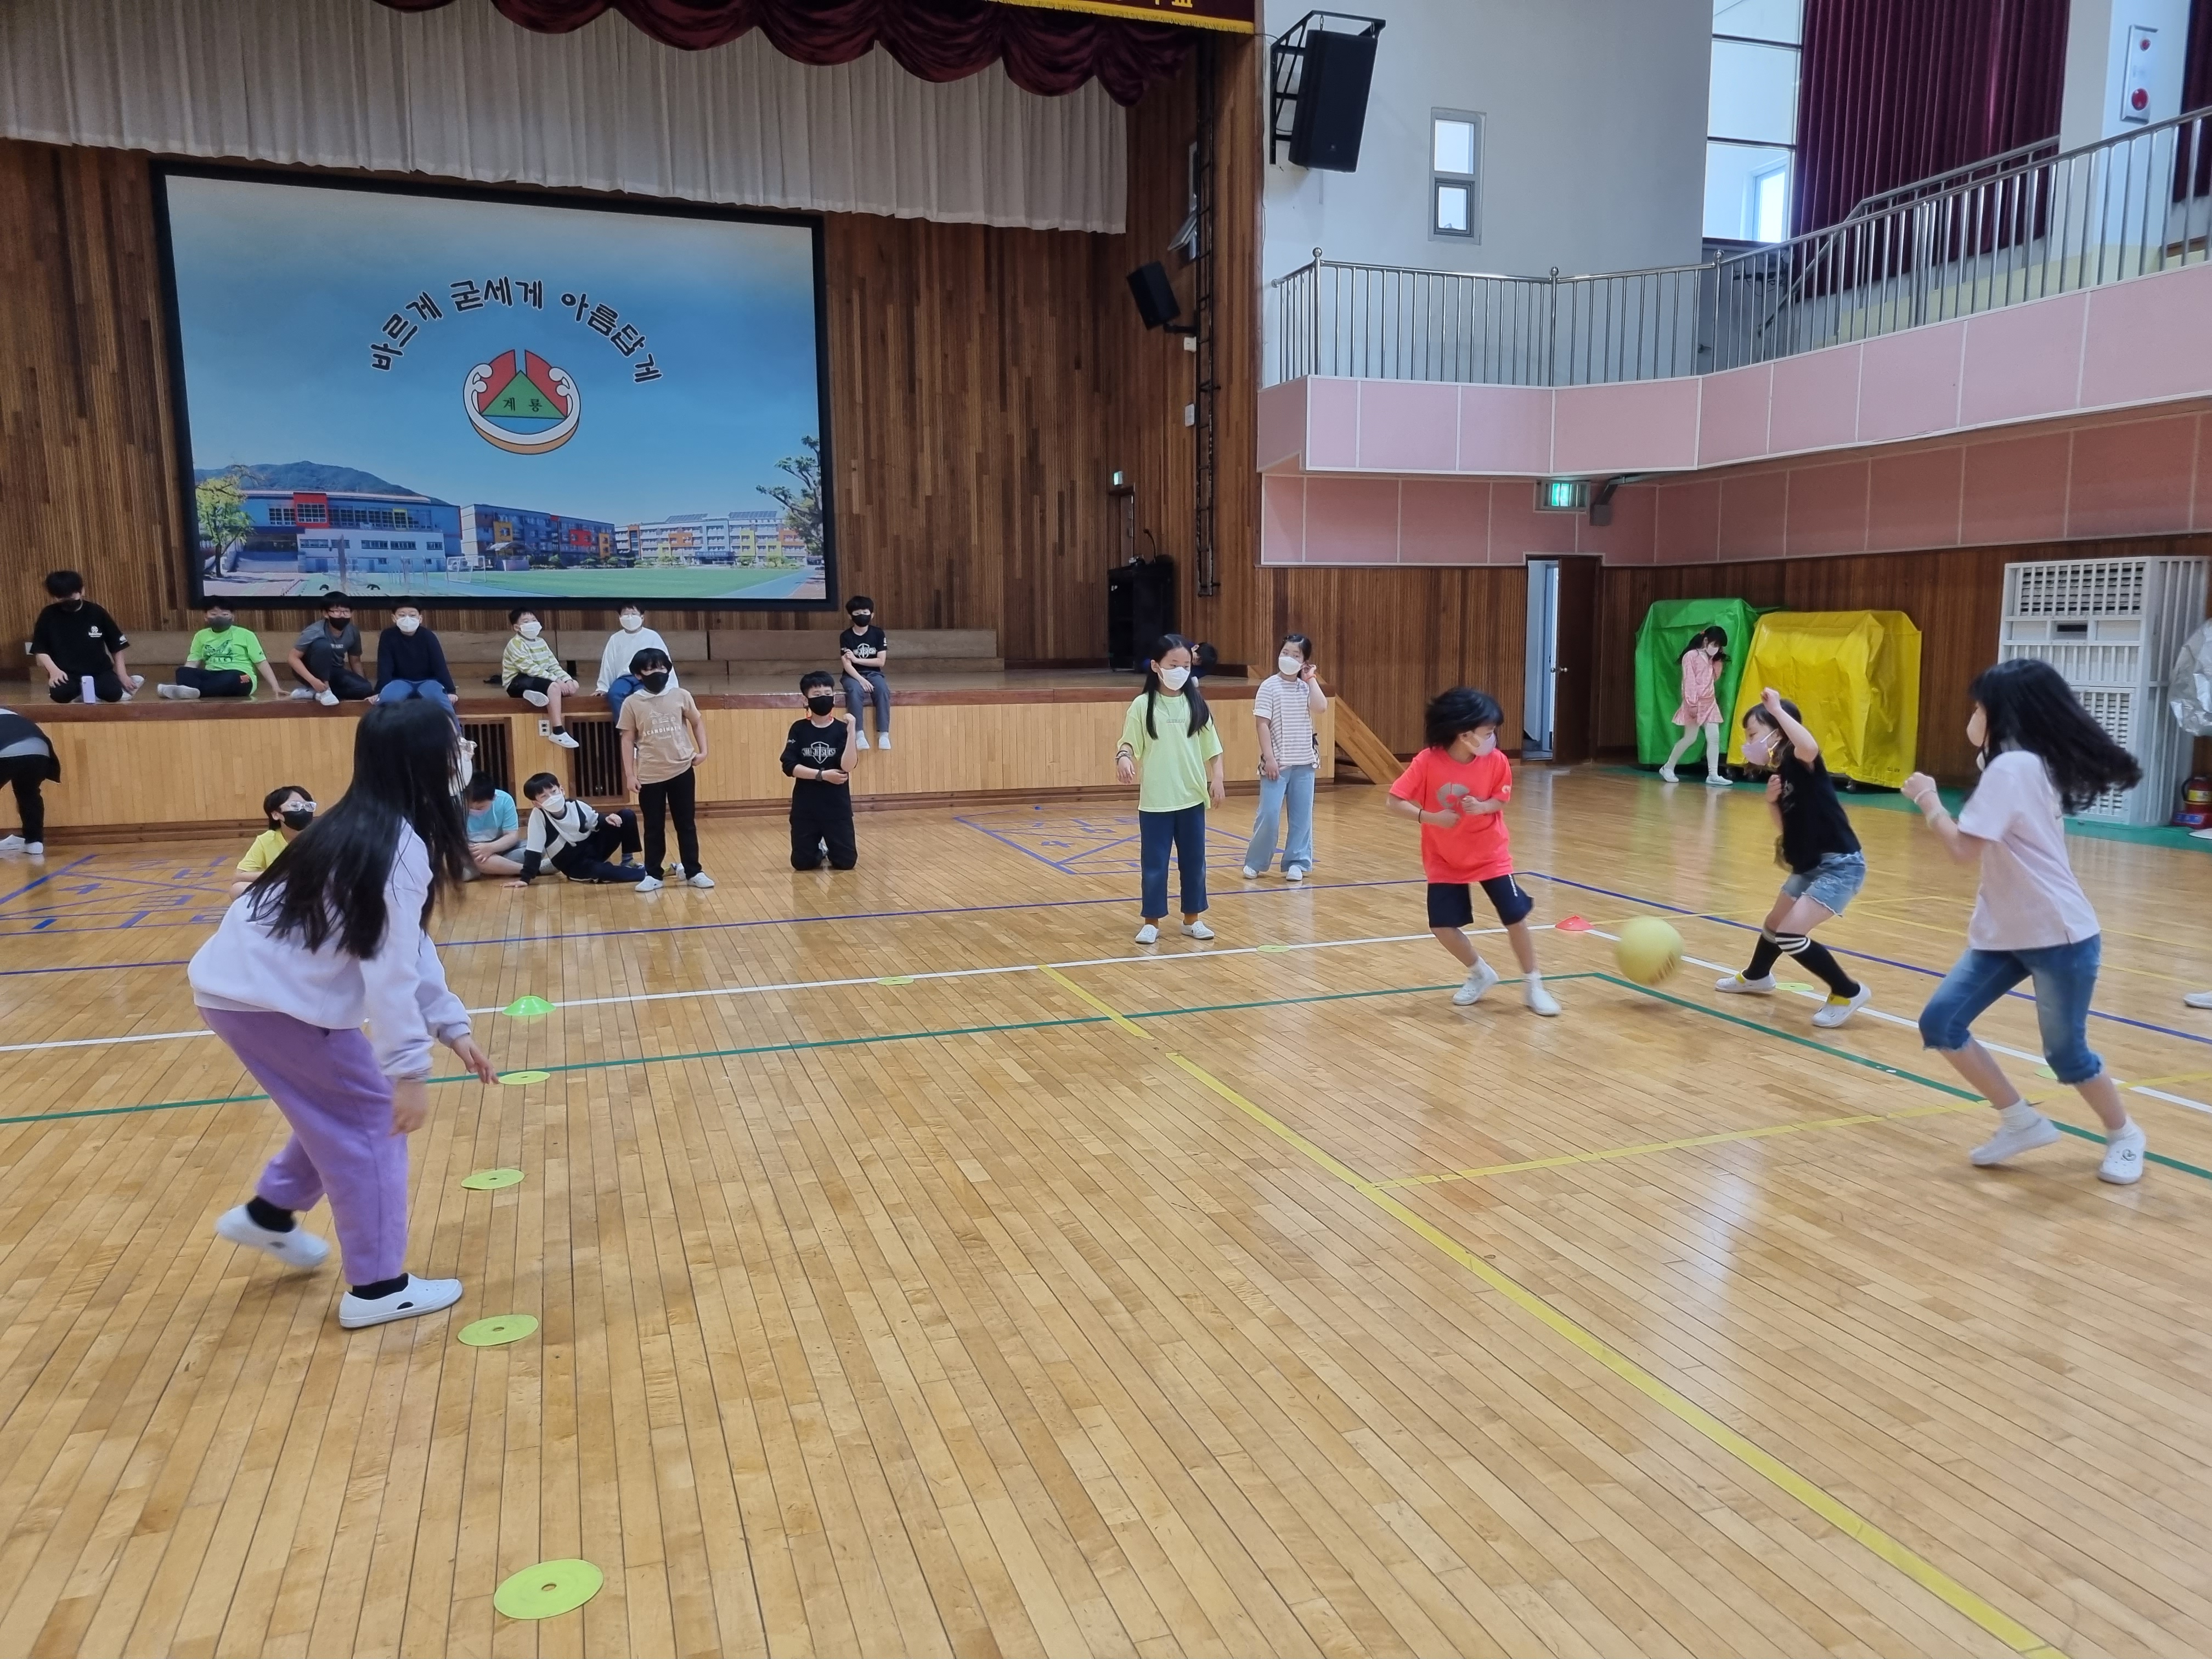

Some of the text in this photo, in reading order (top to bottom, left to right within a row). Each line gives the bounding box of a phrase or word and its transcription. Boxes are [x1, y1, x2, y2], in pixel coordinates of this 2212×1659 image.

[370, 276, 663, 383] 바르게 굳세게 아름답게
[503, 397, 543, 412] 계룡
